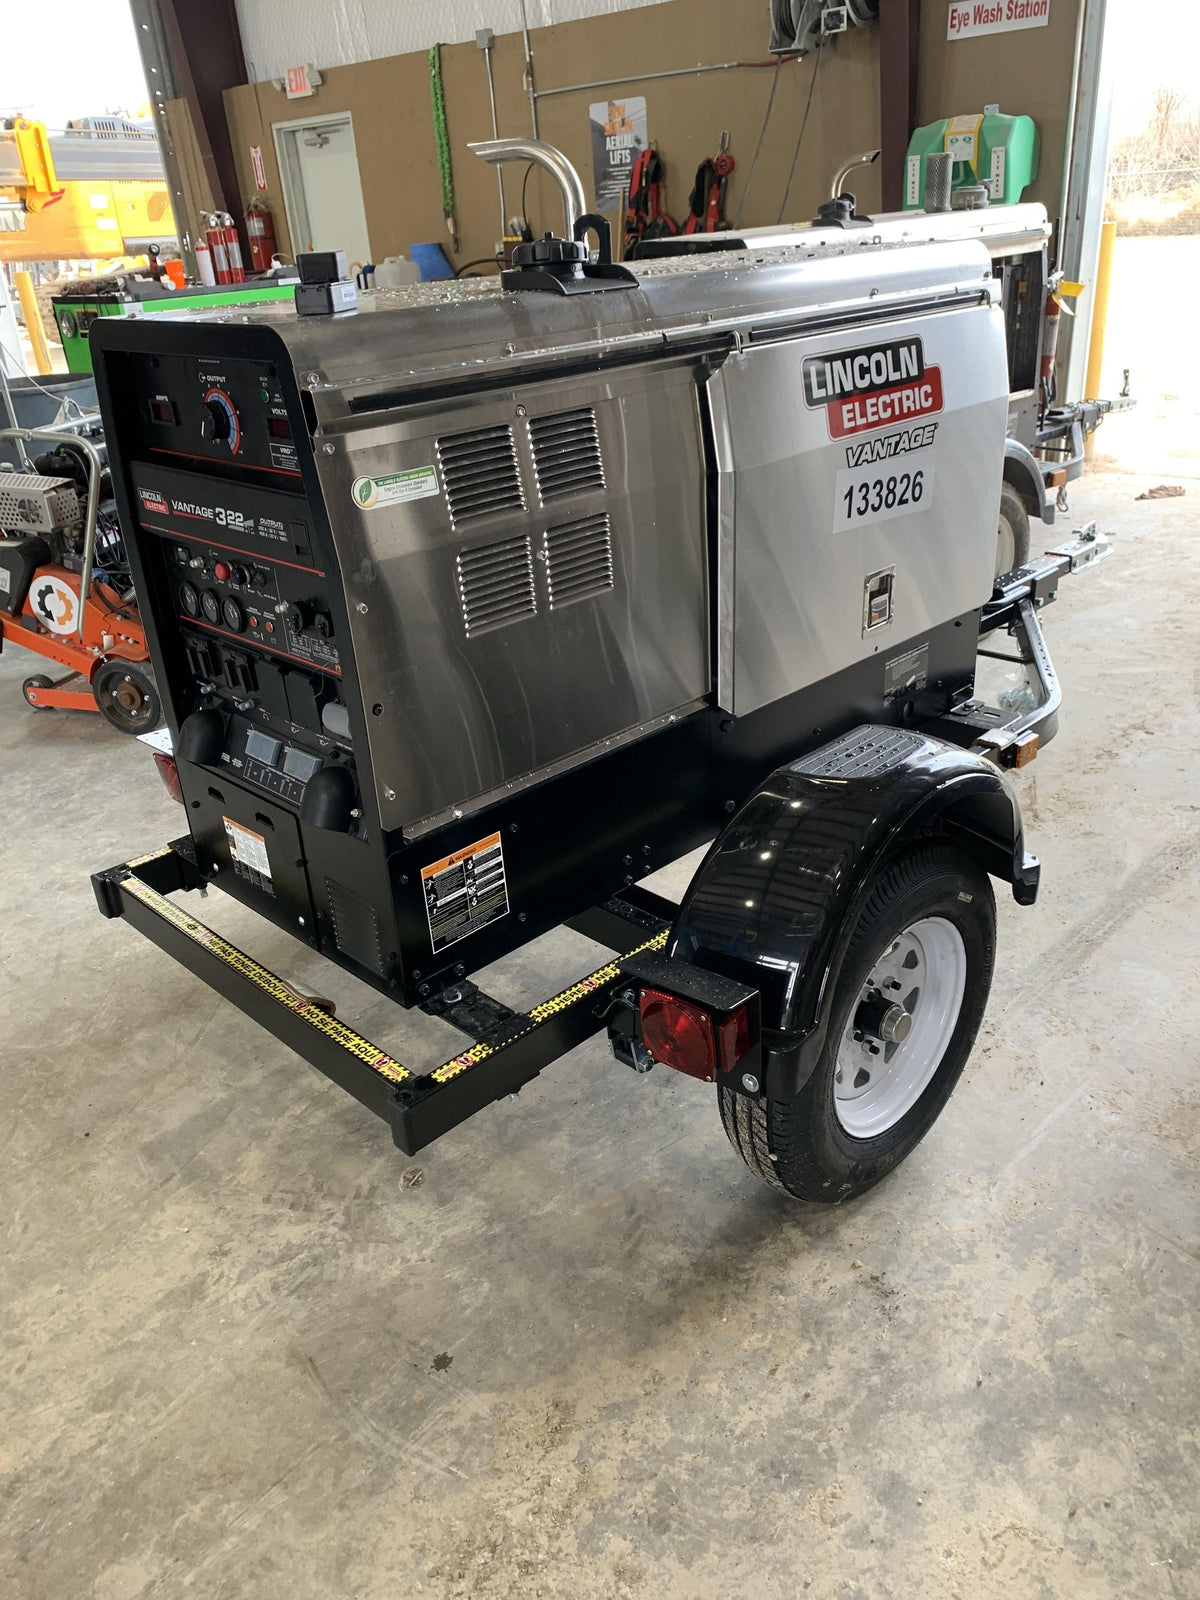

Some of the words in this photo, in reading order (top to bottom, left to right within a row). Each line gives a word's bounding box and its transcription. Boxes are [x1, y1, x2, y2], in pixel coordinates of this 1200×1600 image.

[950, 8, 969, 33] Eye
[973, 2, 1003, 25] Wash
[1006, 0, 1047, 20] Station
[287, 66, 307, 93] EXIT
[606, 134, 634, 150] AERIAL
[610, 150, 631, 164] LIFTS
[206, 375, 226, 383] OUTPUT
[810, 345, 919, 399] LINCOLN
[842, 384, 933, 429] ELECTRIC
[139, 490, 162, 502] LINCOLN
[844, 470, 924, 519] 133826
[146, 501, 167, 511] ELECTRIC
[171, 499, 214, 519] VANTAGE
[215, 507, 244, 527] 322
[162, 907, 185, 923] STAND
[220, 945, 233, 957] PAS
[233, 955, 256, 975] TENEZ
[253, 971, 285, 996] DEBOUT
[285, 991, 297, 1003] ICI
[597, 970, 613, 981] NE
[556, 987, 582, 1004] HERE
[306, 1008, 319, 1019] NO
[317, 1017, 332, 1028] SE
[330, 1026, 354, 1044] PARE
